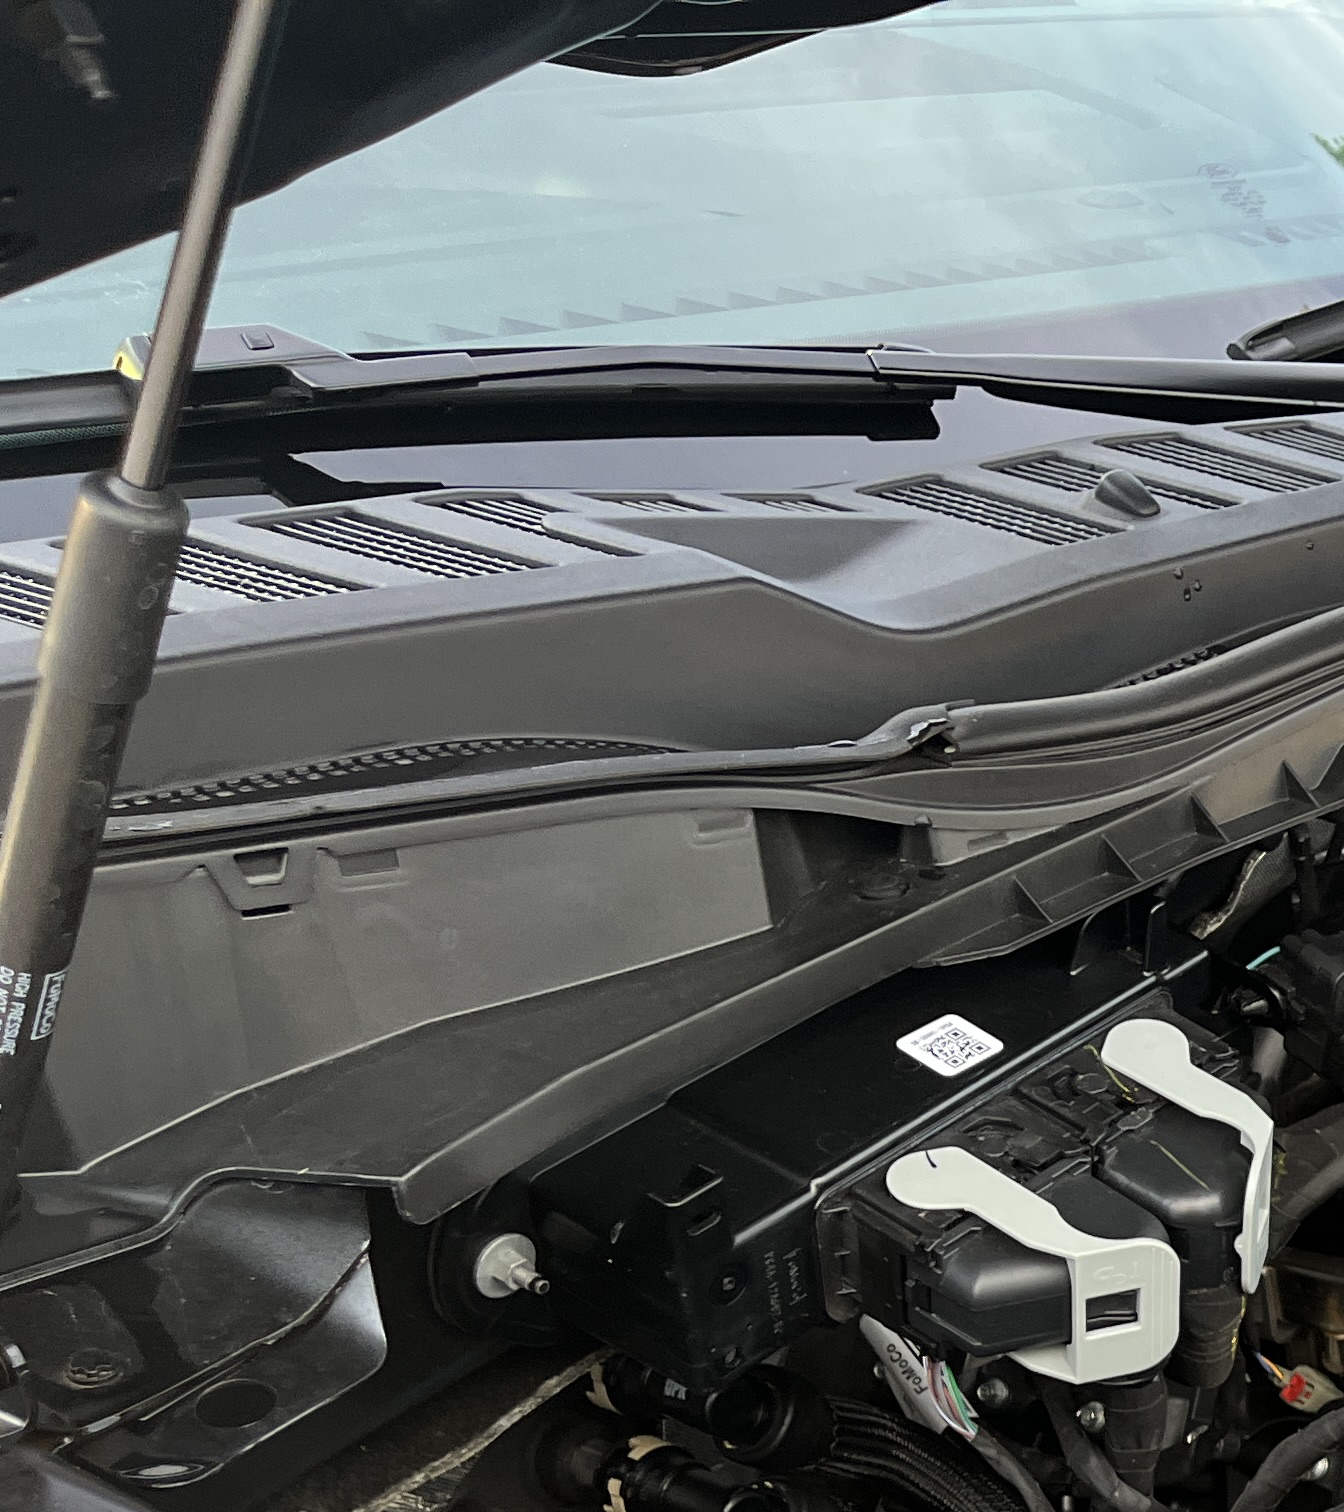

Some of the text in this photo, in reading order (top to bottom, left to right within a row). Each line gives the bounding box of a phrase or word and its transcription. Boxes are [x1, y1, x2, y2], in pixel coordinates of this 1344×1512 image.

[0, 972, 32, 1056] HIGH PRESSURE
[886, 1342, 928, 1396] FoMoCo
